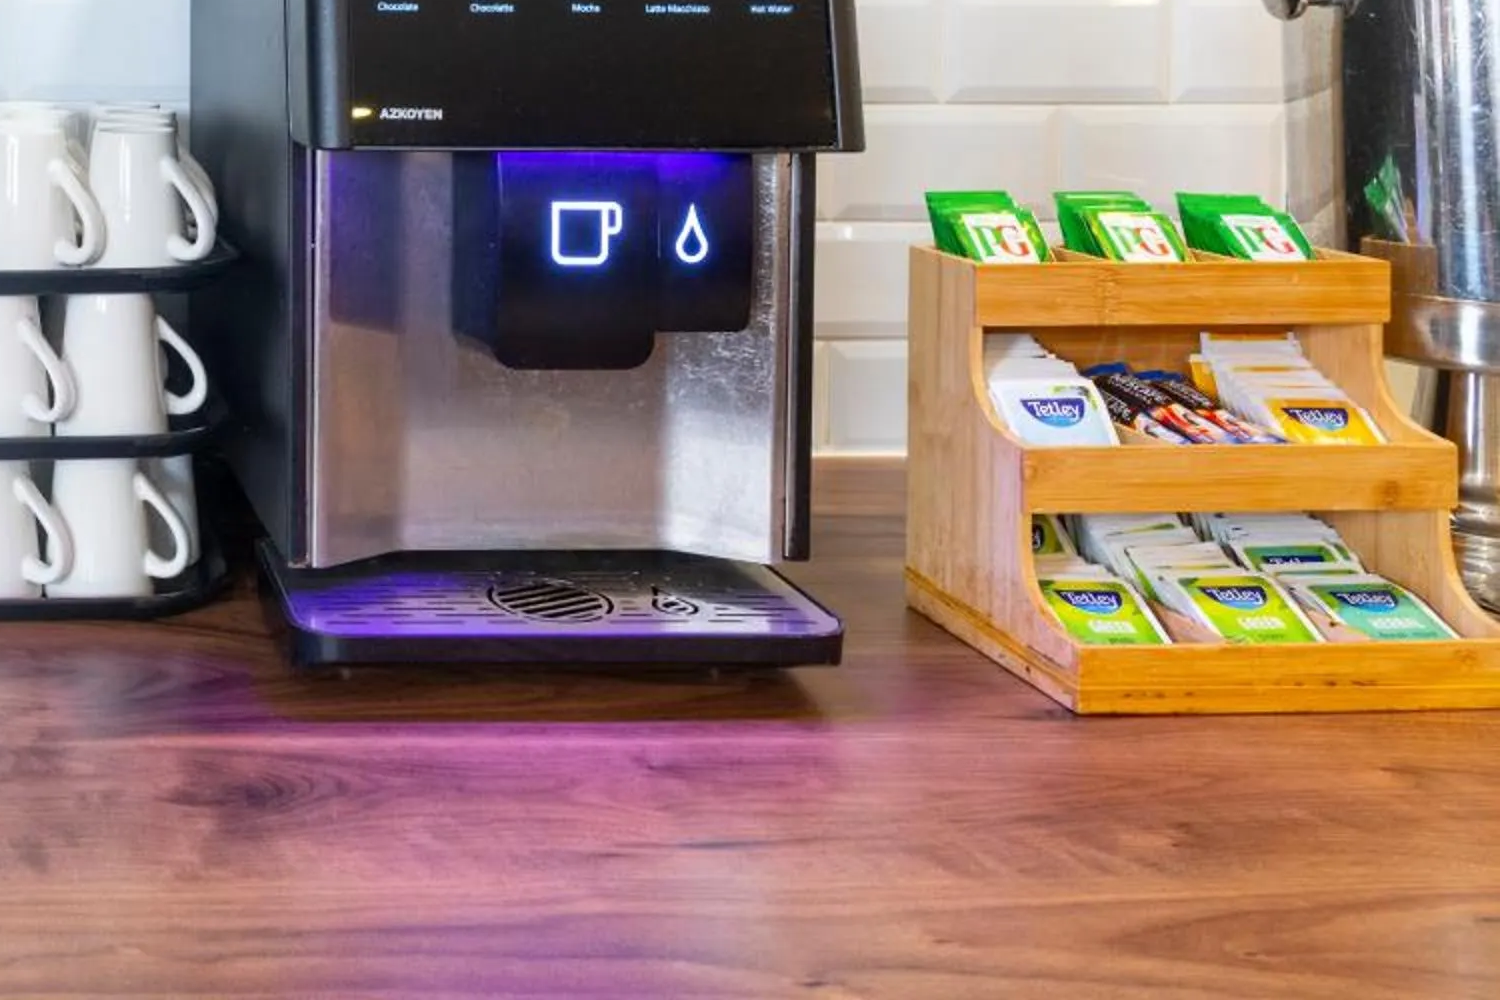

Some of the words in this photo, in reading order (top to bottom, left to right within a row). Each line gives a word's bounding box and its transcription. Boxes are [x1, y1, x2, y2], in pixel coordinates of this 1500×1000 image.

[377, 2, 419, 12] Chocolate
[571, 3, 600, 13] Mocha
[645, 3, 666, 13] Latte
[379, 107, 443, 121] AZKOYEN
[971, 225, 1030, 257] PG
[1110, 224, 1170, 257] PG
[1234, 224, 1296, 254] PG
[1027, 401, 1080, 421] Tetley
[1288, 408, 1345, 428] Tetley
[1060, 591, 1119, 610] Tetley
[1205, 587, 1264, 605] Tetley
[1336, 592, 1396, 608] Tetley
